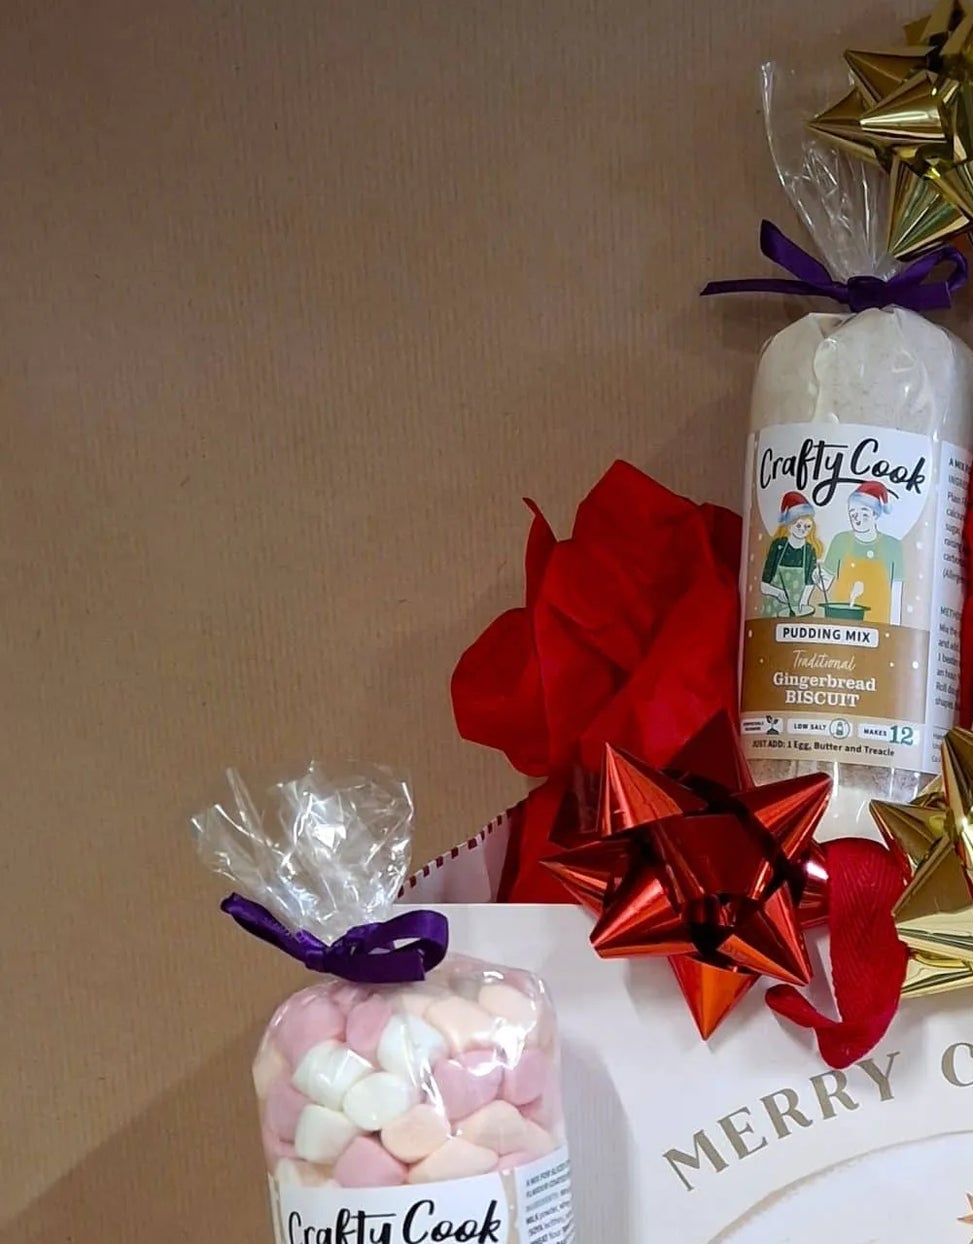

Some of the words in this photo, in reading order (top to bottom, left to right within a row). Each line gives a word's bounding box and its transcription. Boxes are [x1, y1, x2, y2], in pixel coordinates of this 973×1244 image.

[760, 438, 848, 506] Crafty
[851, 438, 927, 495] Cook
[782, 627, 841, 641] PUDDING
[845, 630, 871, 644] MIX
[792, 649, 857, 671] Traditional
[773, 672, 876, 692] Gingerbread
[785, 689, 860, 708] BISCUIT
[793, 722, 809, 731] LOW
[810, 723, 827, 732] SALT
[863, 728, 887, 737] MAKES
[889, 724, 914, 746] 12
[752, 739, 767, 749] JUST
[767, 740, 786, 750] ADD:
[787, 740, 792, 749] 1
[813, 742, 842, 752] Butter
[844, 743, 862, 753] and
[864, 745, 895, 757] Treacle
[661, 1050, 902, 1192] MERRY
